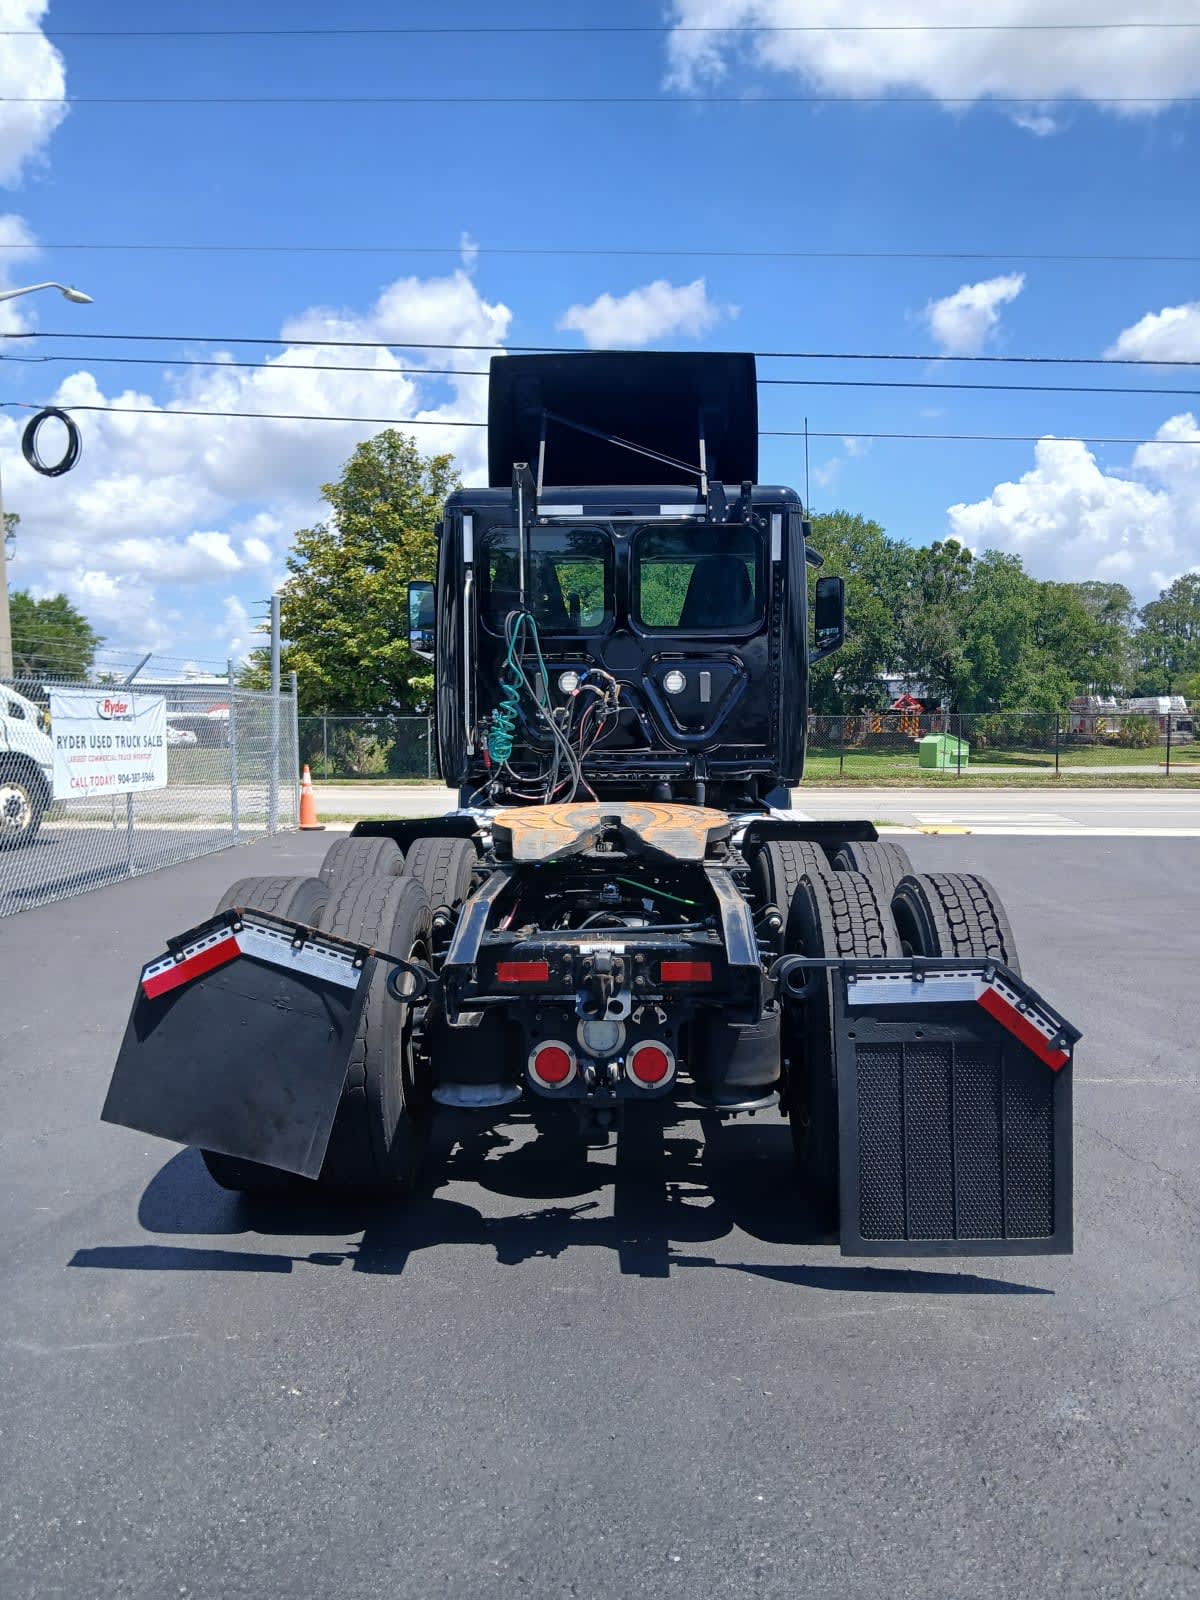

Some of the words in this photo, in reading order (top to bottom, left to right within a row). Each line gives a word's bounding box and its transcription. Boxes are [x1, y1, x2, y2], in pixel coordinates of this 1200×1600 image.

[104, 699, 128, 716] Ryder
[57, 736, 87, 749] RYDER
[90, 736, 112, 748] USED
[116, 735, 141, 748] TRUCK
[144, 735, 163, 747] SALES
[70, 776, 88, 788] CALL
[90, 775, 116, 786] TODAY!
